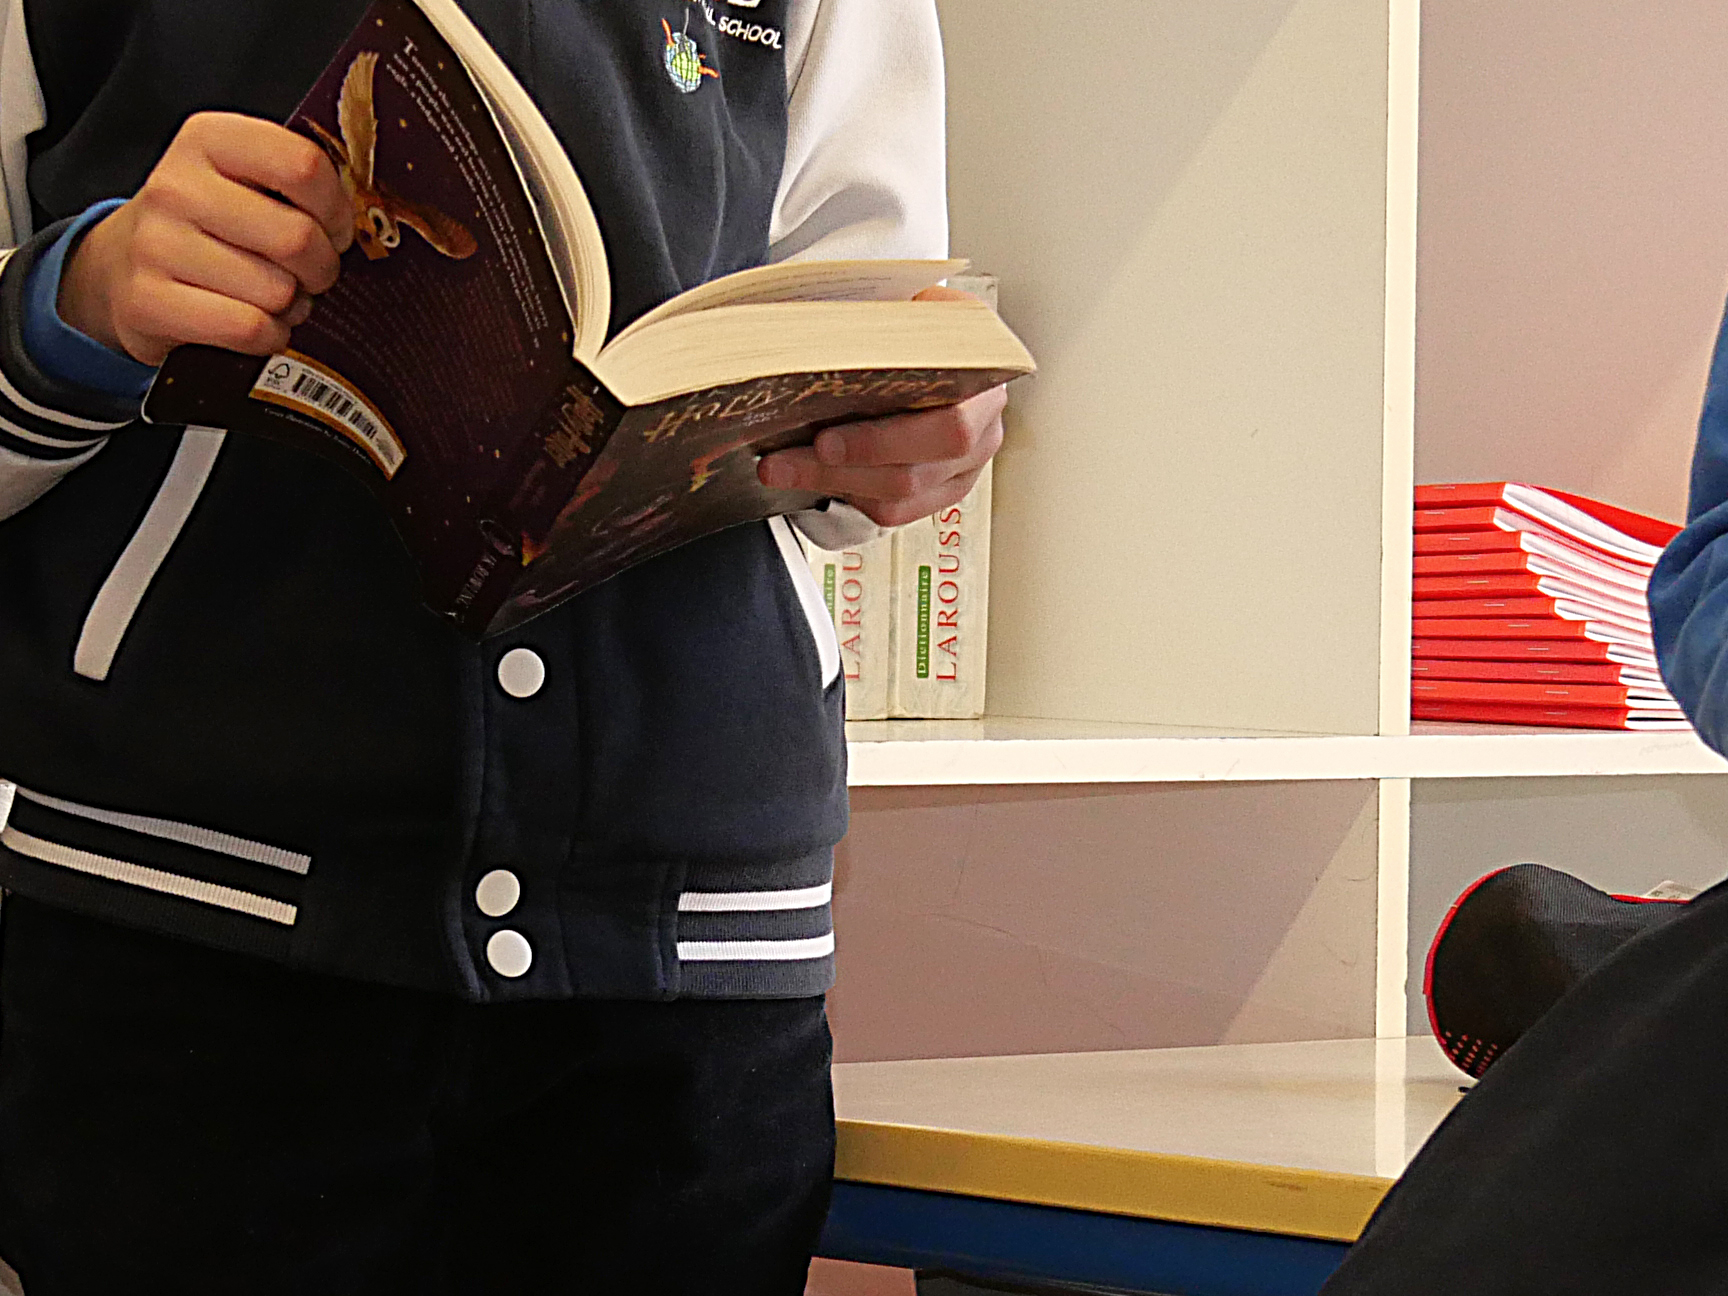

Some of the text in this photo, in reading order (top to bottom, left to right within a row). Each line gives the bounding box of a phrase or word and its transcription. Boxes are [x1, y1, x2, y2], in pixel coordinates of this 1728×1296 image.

[719, 17, 782, 49] SCHOOL
[842, 552, 863, 681] LAROU
[936, 507, 961, 682] LAROUSS
